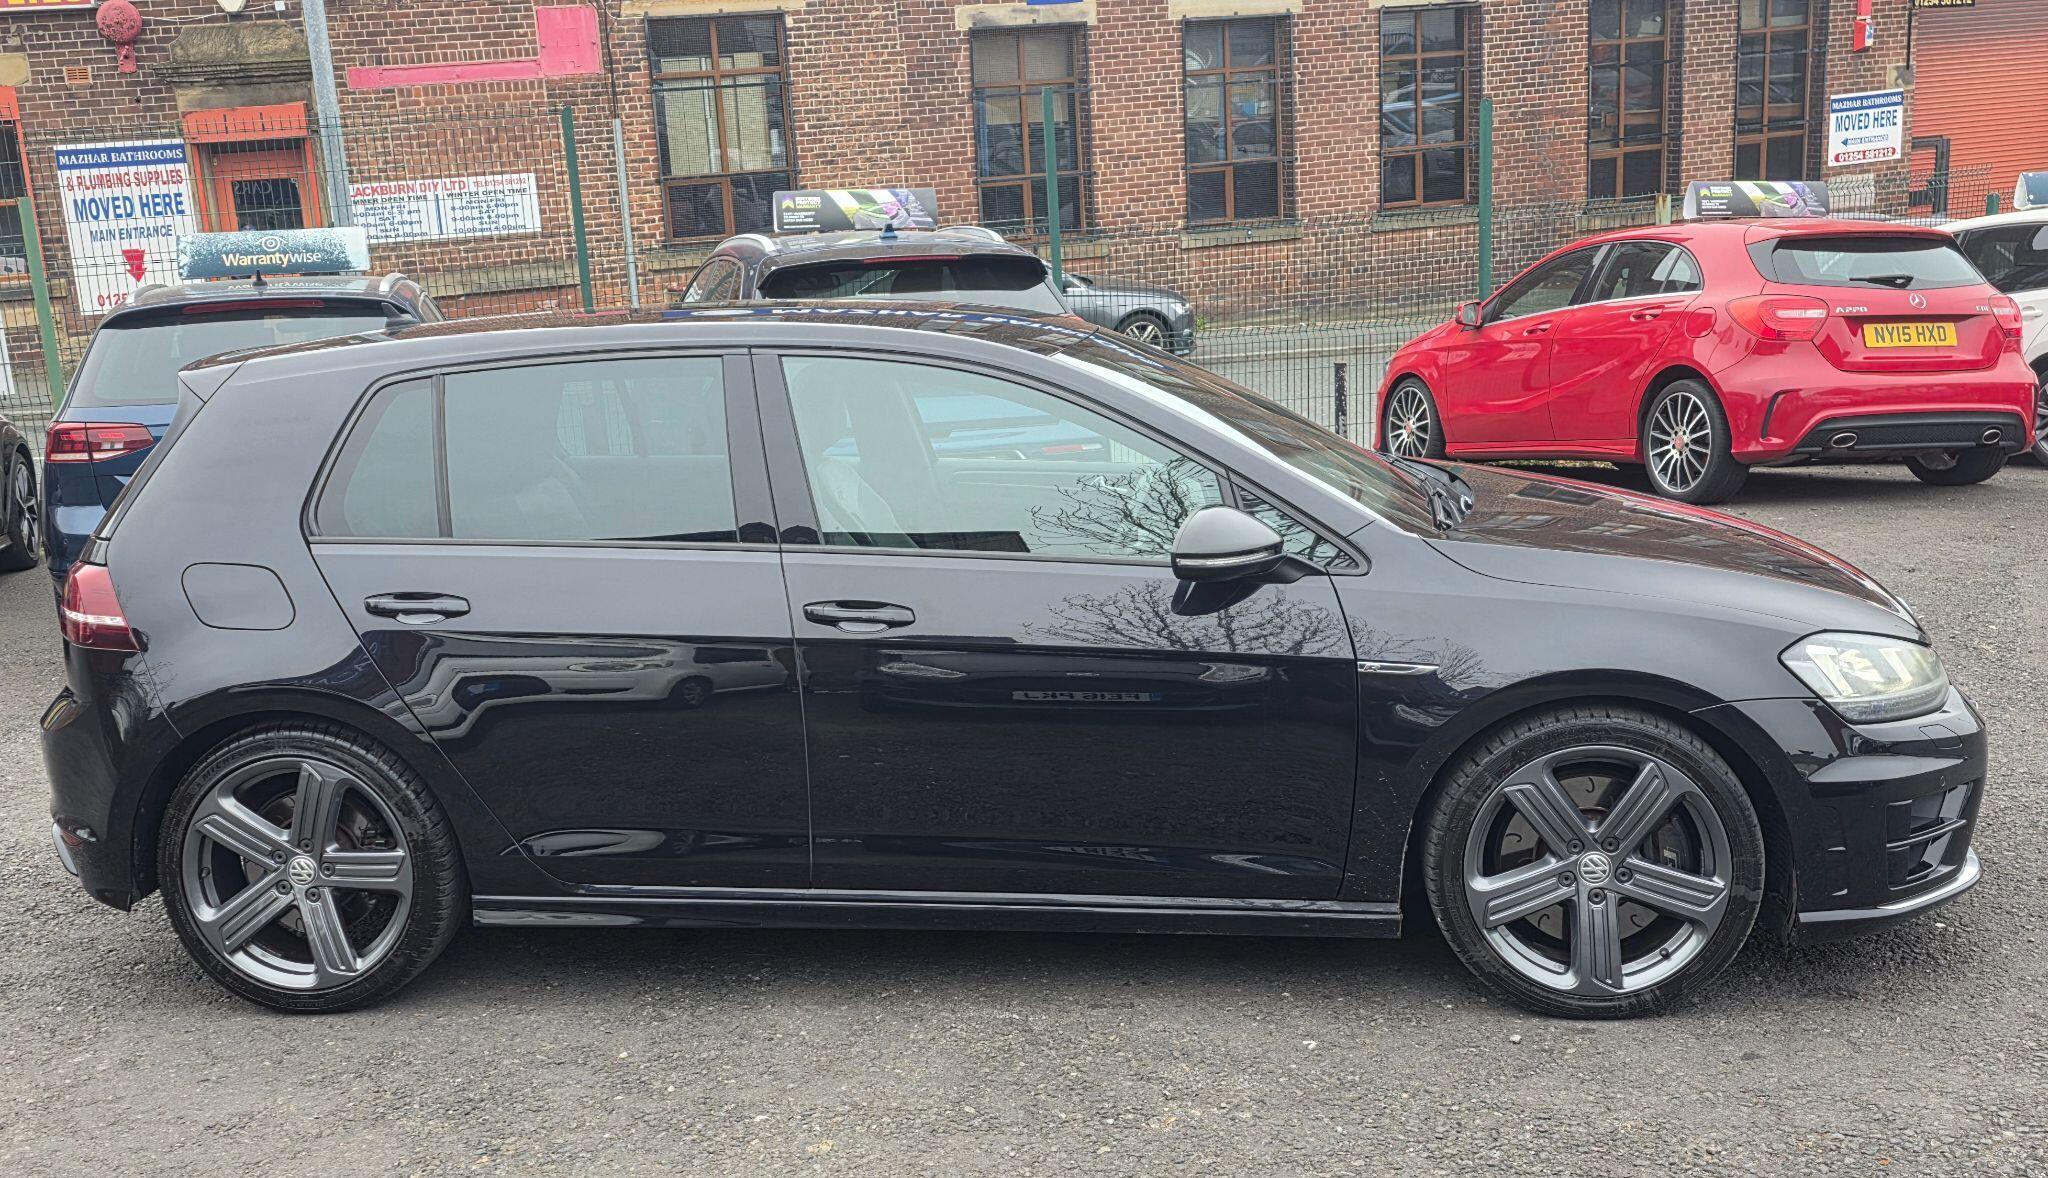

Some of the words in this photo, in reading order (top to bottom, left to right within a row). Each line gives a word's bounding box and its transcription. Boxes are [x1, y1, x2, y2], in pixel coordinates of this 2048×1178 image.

[1862, 94, 1902, 107] BATHROOMS
[1835, 112, 1870, 133] MOVED
[1873, 109, 1898, 128] HERE
[59, 153, 109, 166] MAZHAR
[112, 149, 183, 163] BATHROOMS
[77, 172, 131, 191] PLUMBING
[134, 168, 184, 187] SUPPLIES
[350, 182, 415, 198] ACKBURN
[419, 181, 439, 193] DIY
[443, 180, 467, 192] LTD
[73, 195, 135, 221] MOVED
[138, 192, 185, 217] HERE
[90, 229, 116, 242] MAIN
[120, 224, 173, 240] ENTRANCE
[222, 250, 322, 268] Warrantywise
[97, 292, 128, 308] 0125
[1873, 324, 1911, 345] NY15
[1916, 325, 1947, 344] HXD
